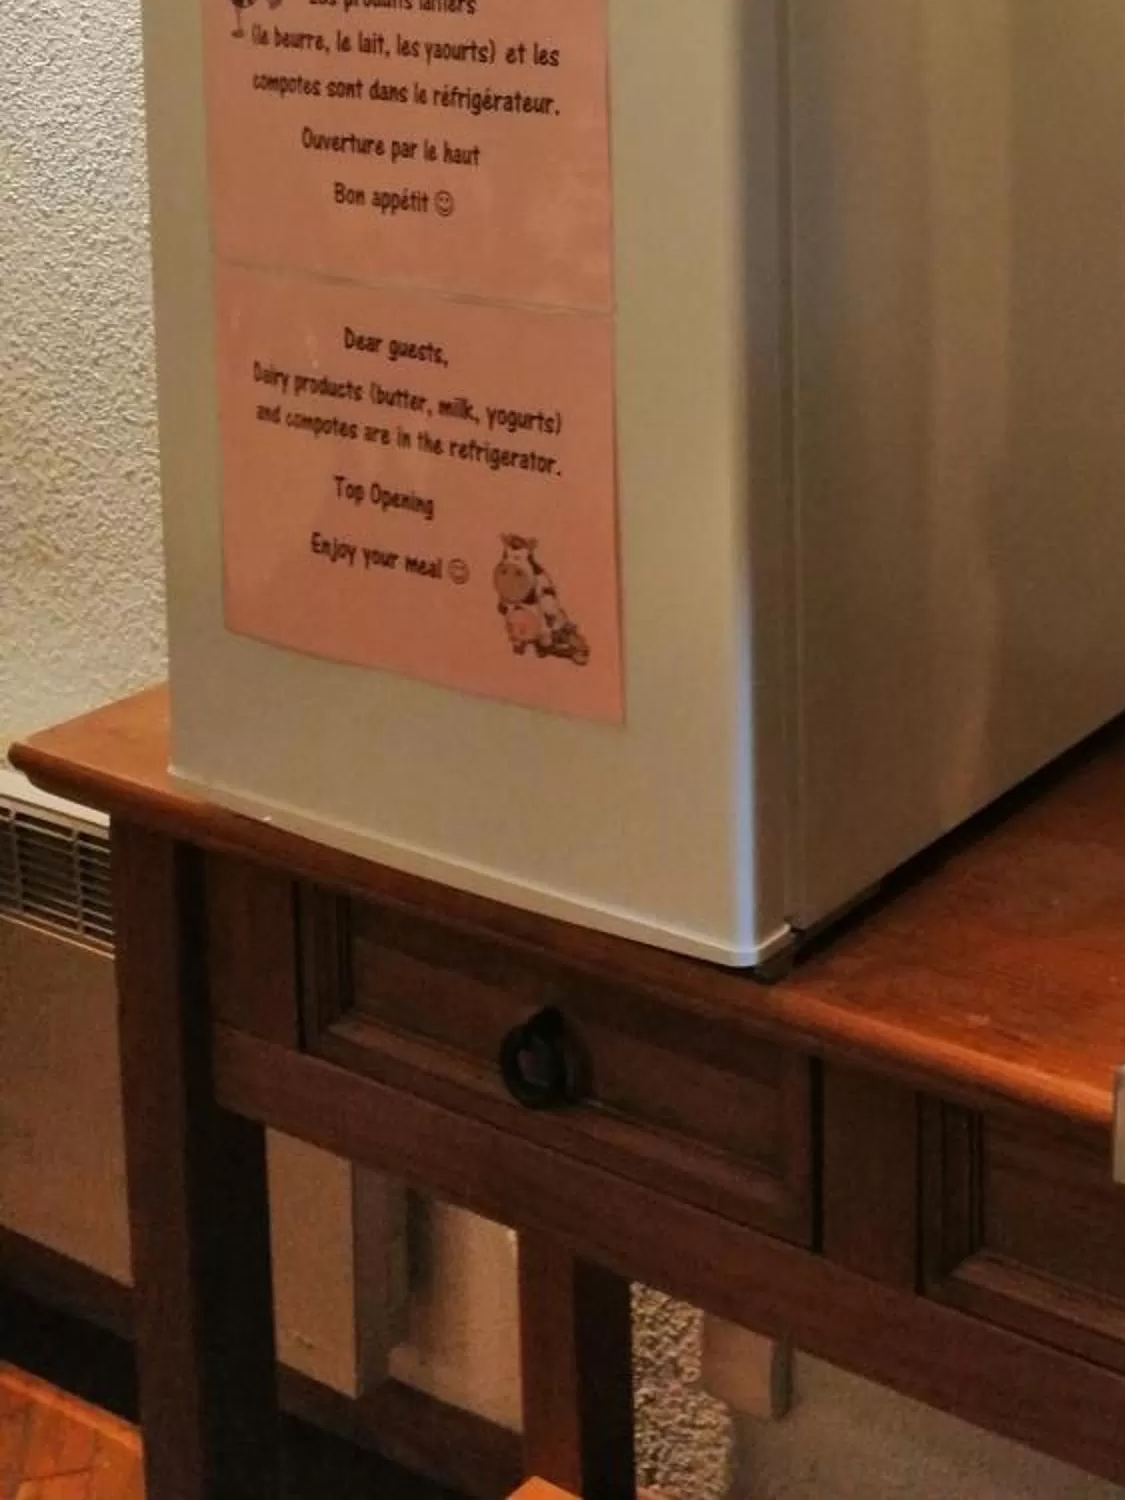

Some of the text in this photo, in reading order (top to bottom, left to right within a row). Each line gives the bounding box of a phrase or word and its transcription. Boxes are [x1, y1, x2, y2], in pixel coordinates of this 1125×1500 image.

[274, 30, 330, 55] beurre,
[336, 30, 352, 52] le
[397, 35, 420, 57] les
[425, 39, 497, 65] yaourts)
[505, 44, 526, 65] et
[533, 42, 560, 67] les
[252, 72, 321, 98] compotes
[326, 79, 363, 99] sont
[369, 80, 407, 103] dans
[414, 83, 428, 106] le
[301, 127, 480, 167] Ouverture par le haut
[334, 182, 429, 215] Bon appétit
[344, 326, 383, 353] Dear
[253, 360, 289, 394] Dairy
[294, 373, 363, 402] products
[486, 404, 563, 436] yogurts)
[256, 403, 281, 425] and
[285, 411, 358, 441] compotes
[364, 426, 390, 445] are
[397, 426, 411, 448] in
[417, 429, 444, 456] the
[333, 474, 435, 520] Top Opening
[311, 531, 443, 579] Enjoy your meal
